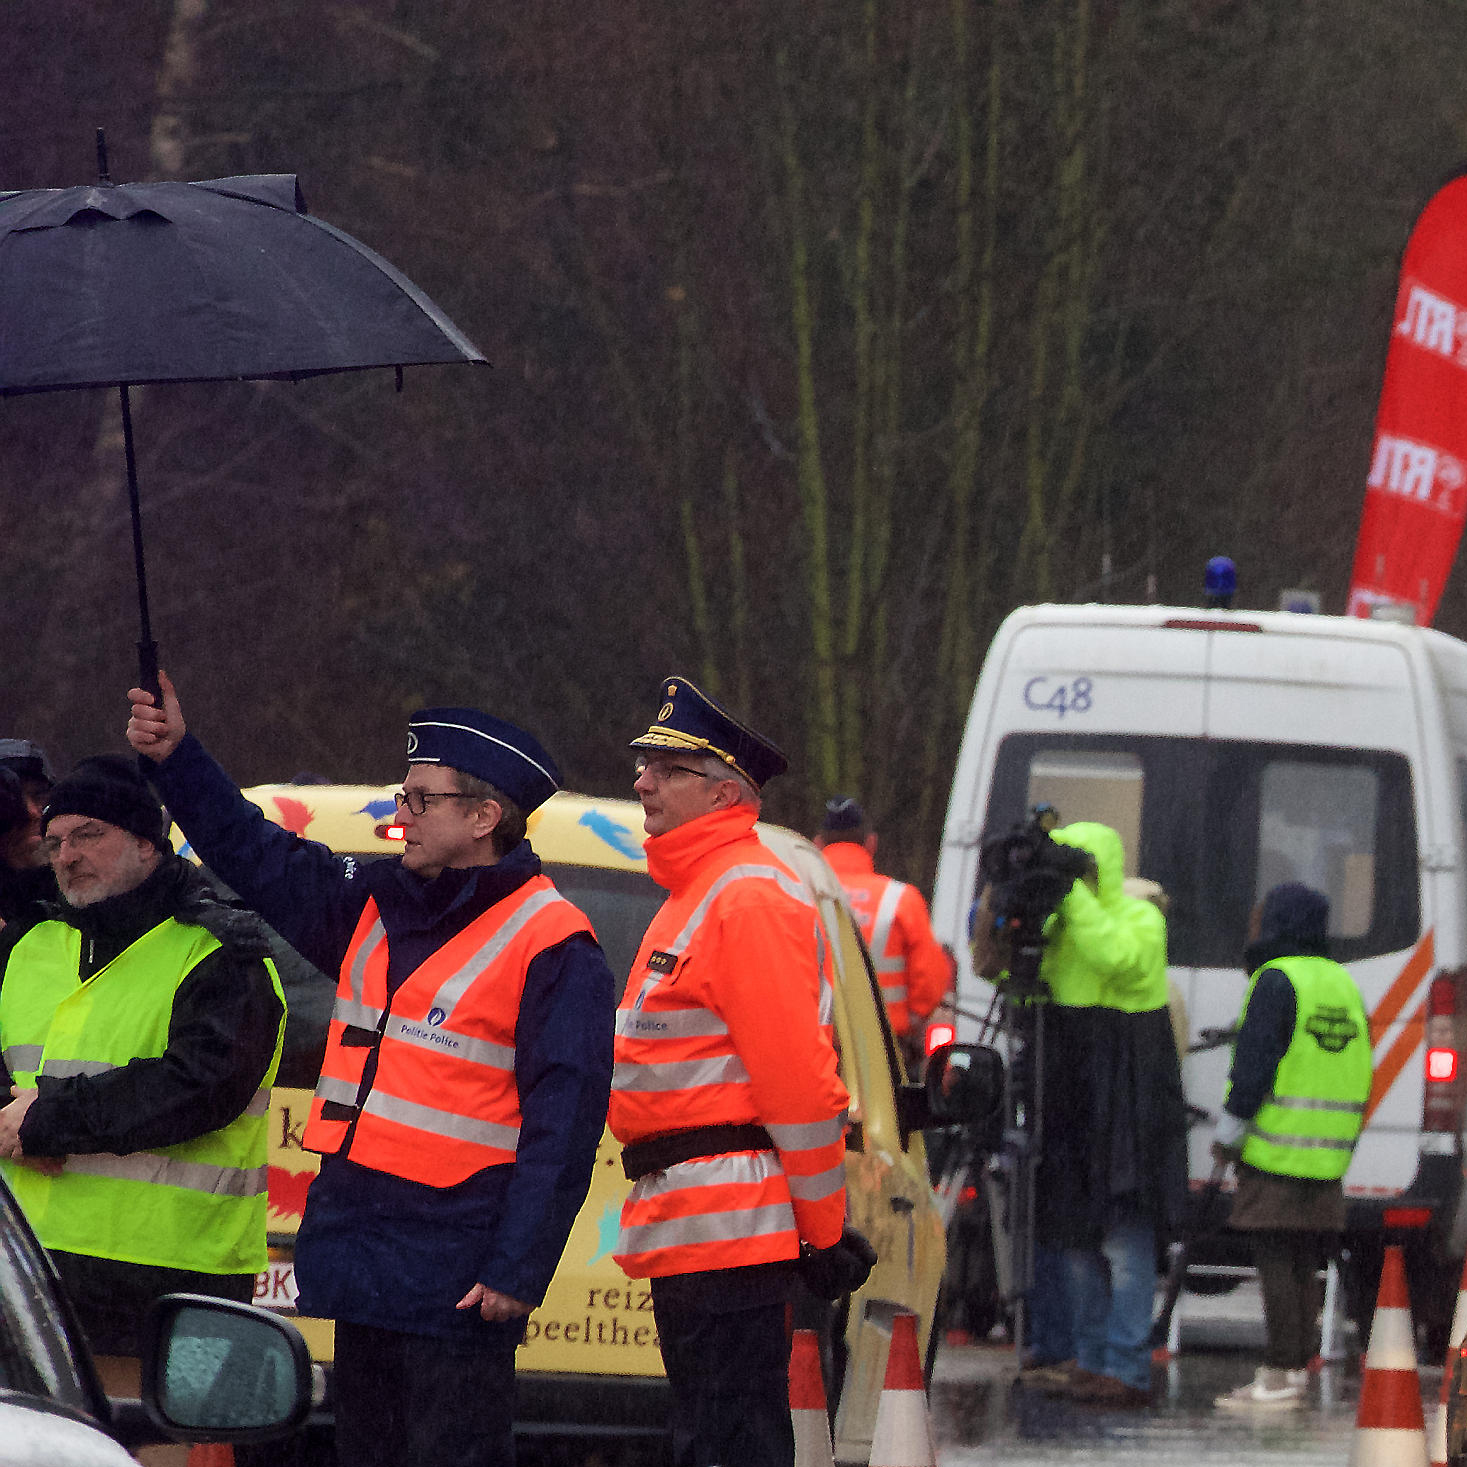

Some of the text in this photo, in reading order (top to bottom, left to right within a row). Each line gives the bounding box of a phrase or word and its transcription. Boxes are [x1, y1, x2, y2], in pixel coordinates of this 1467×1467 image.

[1023, 676, 1092, 719] C48
[400, 1024, 460, 1049] Politie Police
[635, 1018, 668, 1031] Police
[521, 1314, 662, 1348] peelthe
